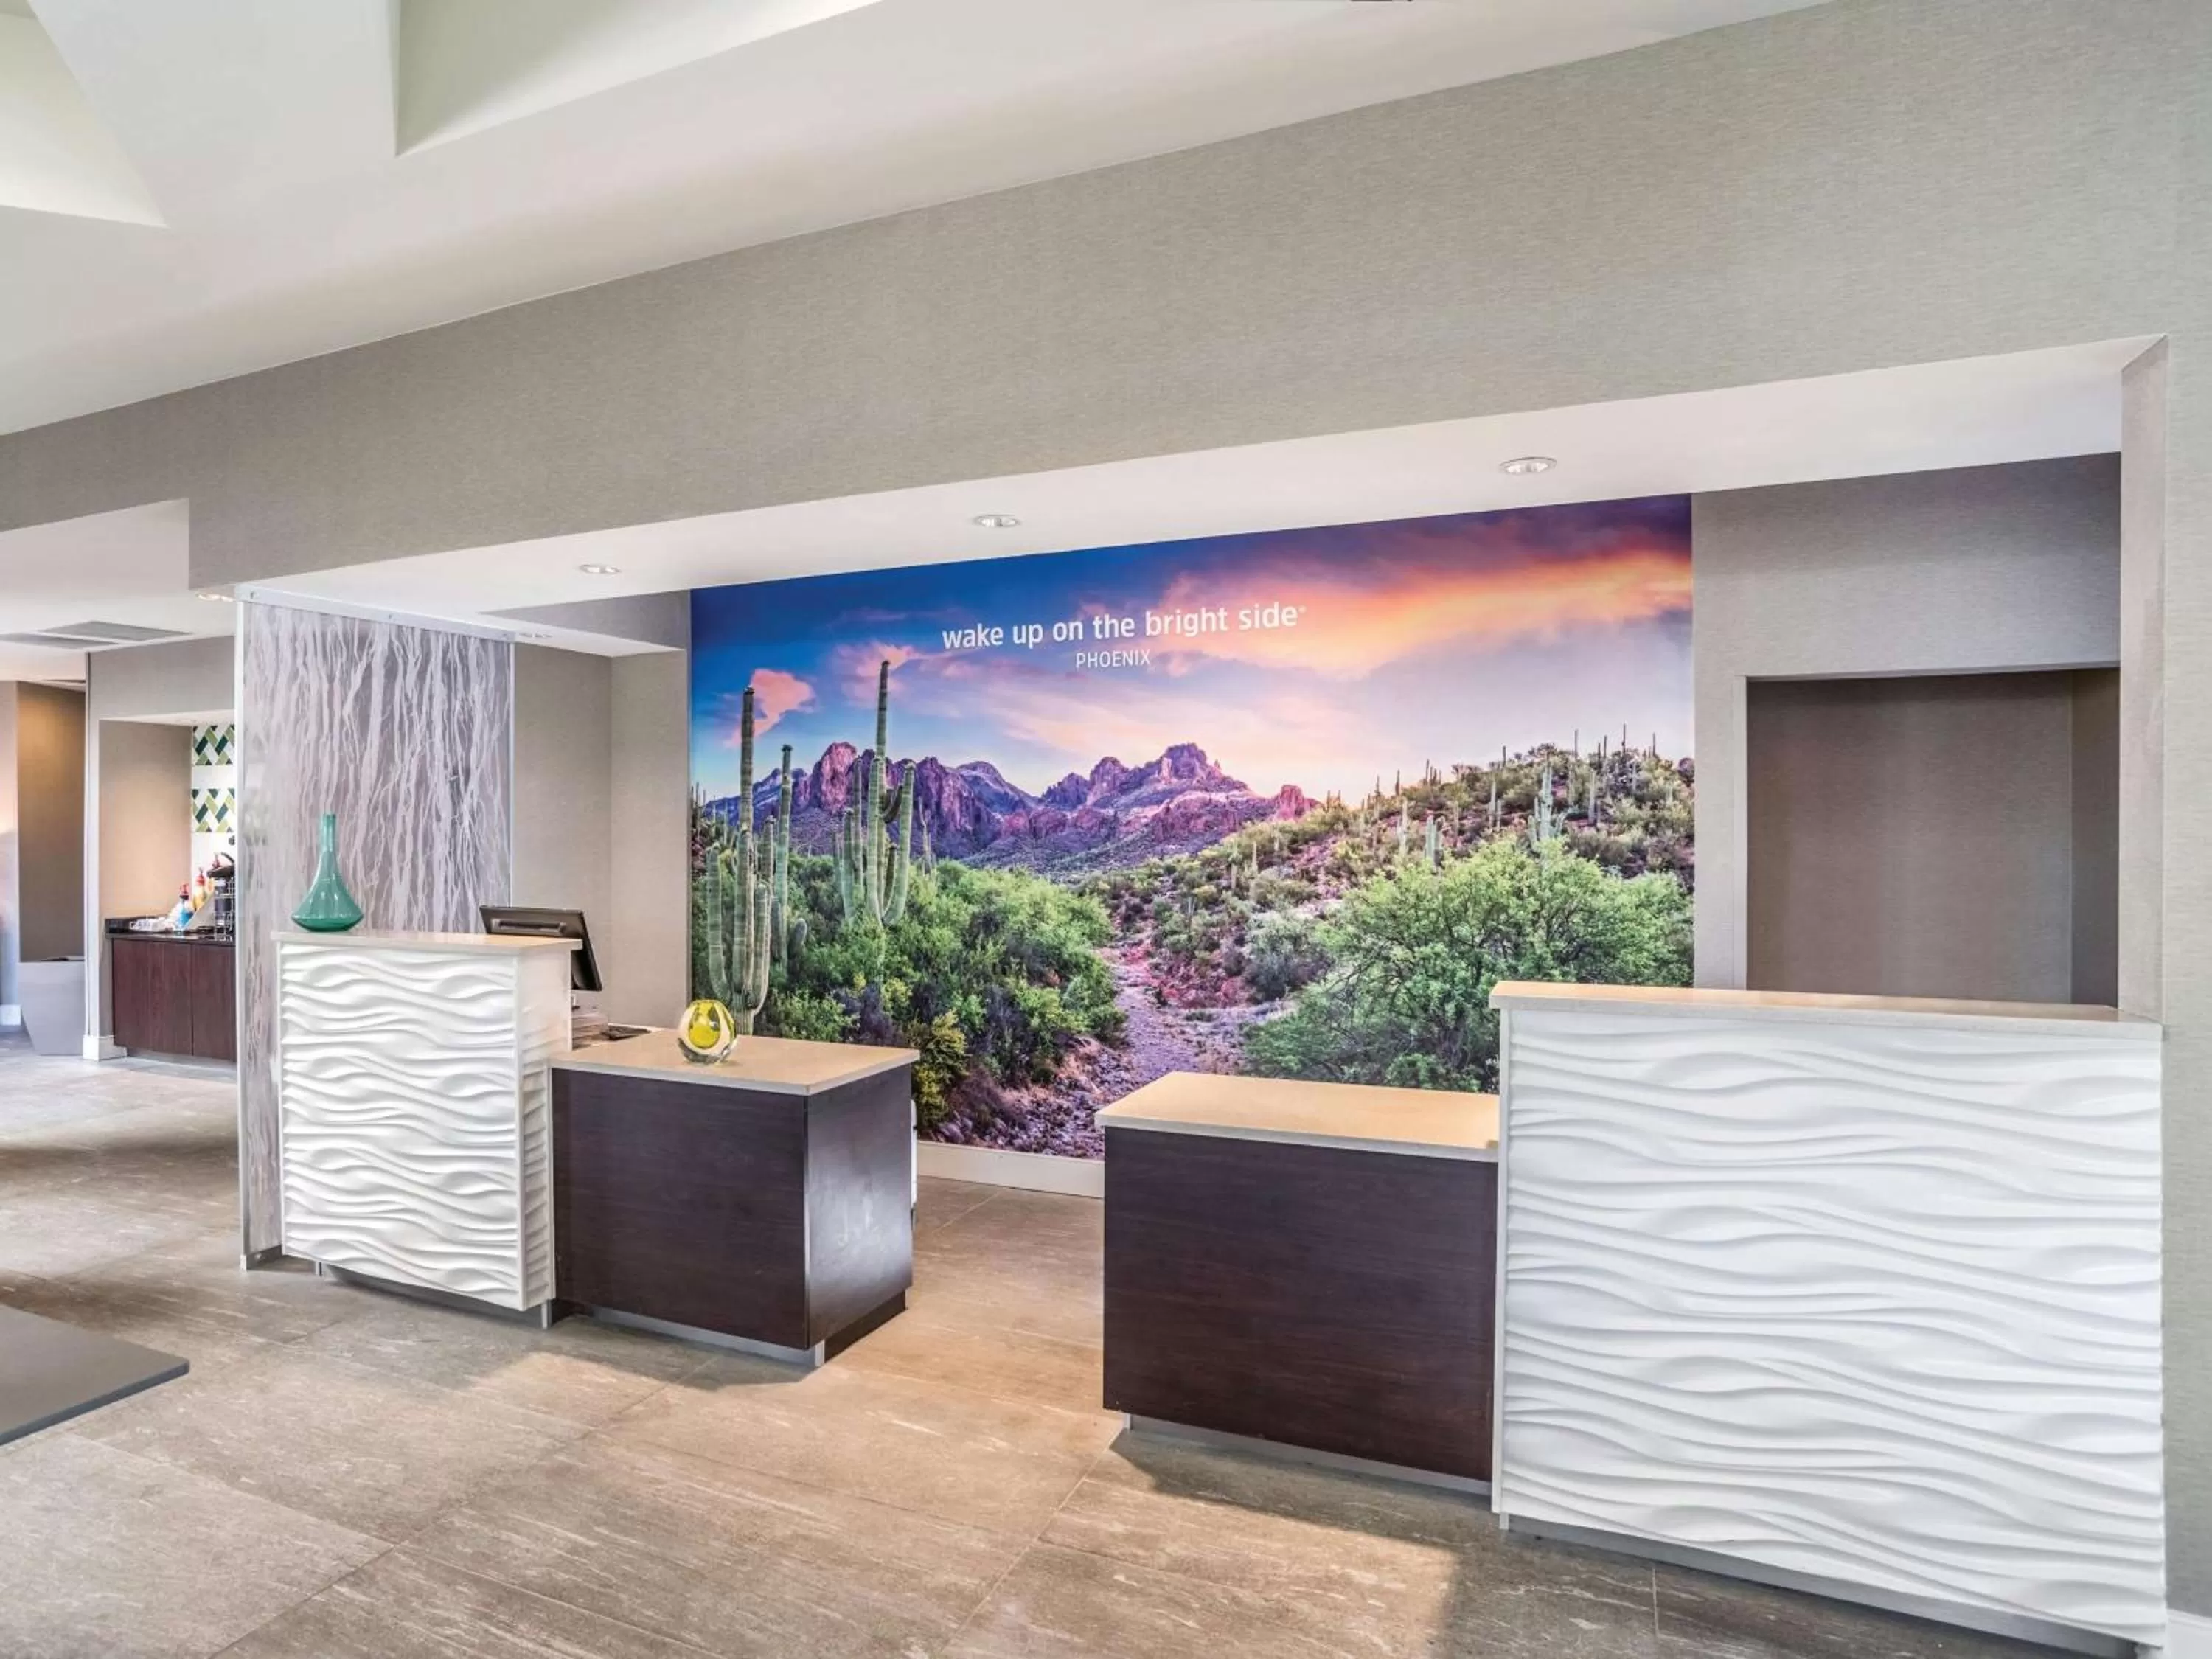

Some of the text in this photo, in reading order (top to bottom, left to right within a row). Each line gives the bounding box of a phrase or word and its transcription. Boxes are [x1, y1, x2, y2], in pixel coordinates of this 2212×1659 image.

[942, 622, 1004, 650] wake
[1012, 625, 1044, 649] up
[1052, 620, 1084, 642] on
[1093, 613, 1135, 640] the
[1145, 606, 1228, 639] bright
[1075, 648, 1151, 669] PHOENIX
